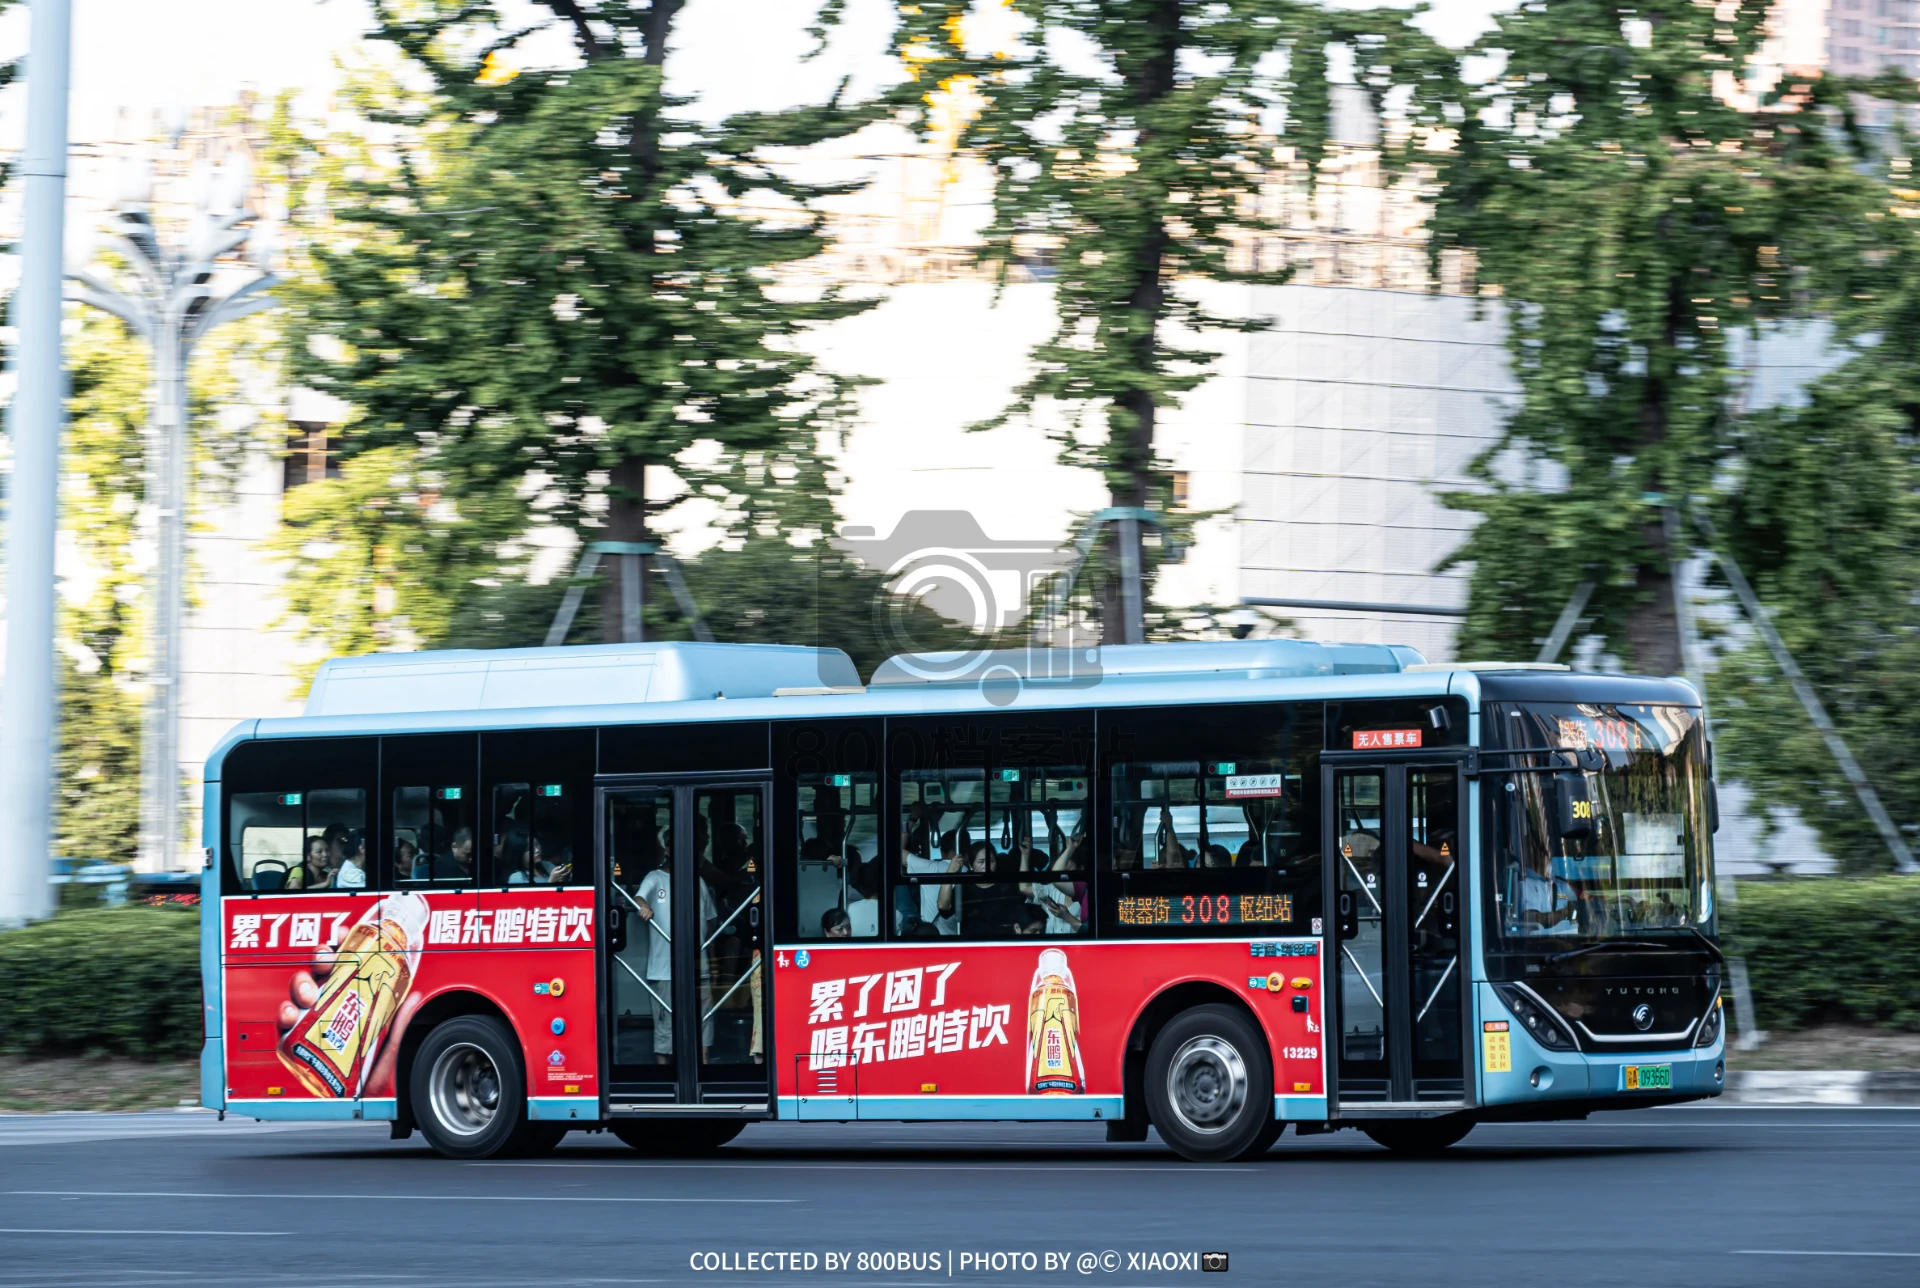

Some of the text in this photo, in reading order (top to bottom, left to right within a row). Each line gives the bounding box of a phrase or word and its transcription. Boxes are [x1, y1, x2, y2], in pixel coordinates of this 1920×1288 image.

[1358, 732, 1417, 747] 无人售票车
[1594, 719, 1628, 749] 308
[427, 905, 593, 944] 喝东鹏特饮
[1118, 894, 1293, 925] 磁器街 308 枢纽站
[230, 911, 352, 949] 累了困了
[807, 961, 962, 1024] 累了困了
[1605, 987, 1679, 995] YUTONG
[808, 1004, 1010, 1071] 喝东鹏特饮
[1047, 1029, 1061, 1060] 东鹏
[1283, 1047, 1318, 1059] 13229
